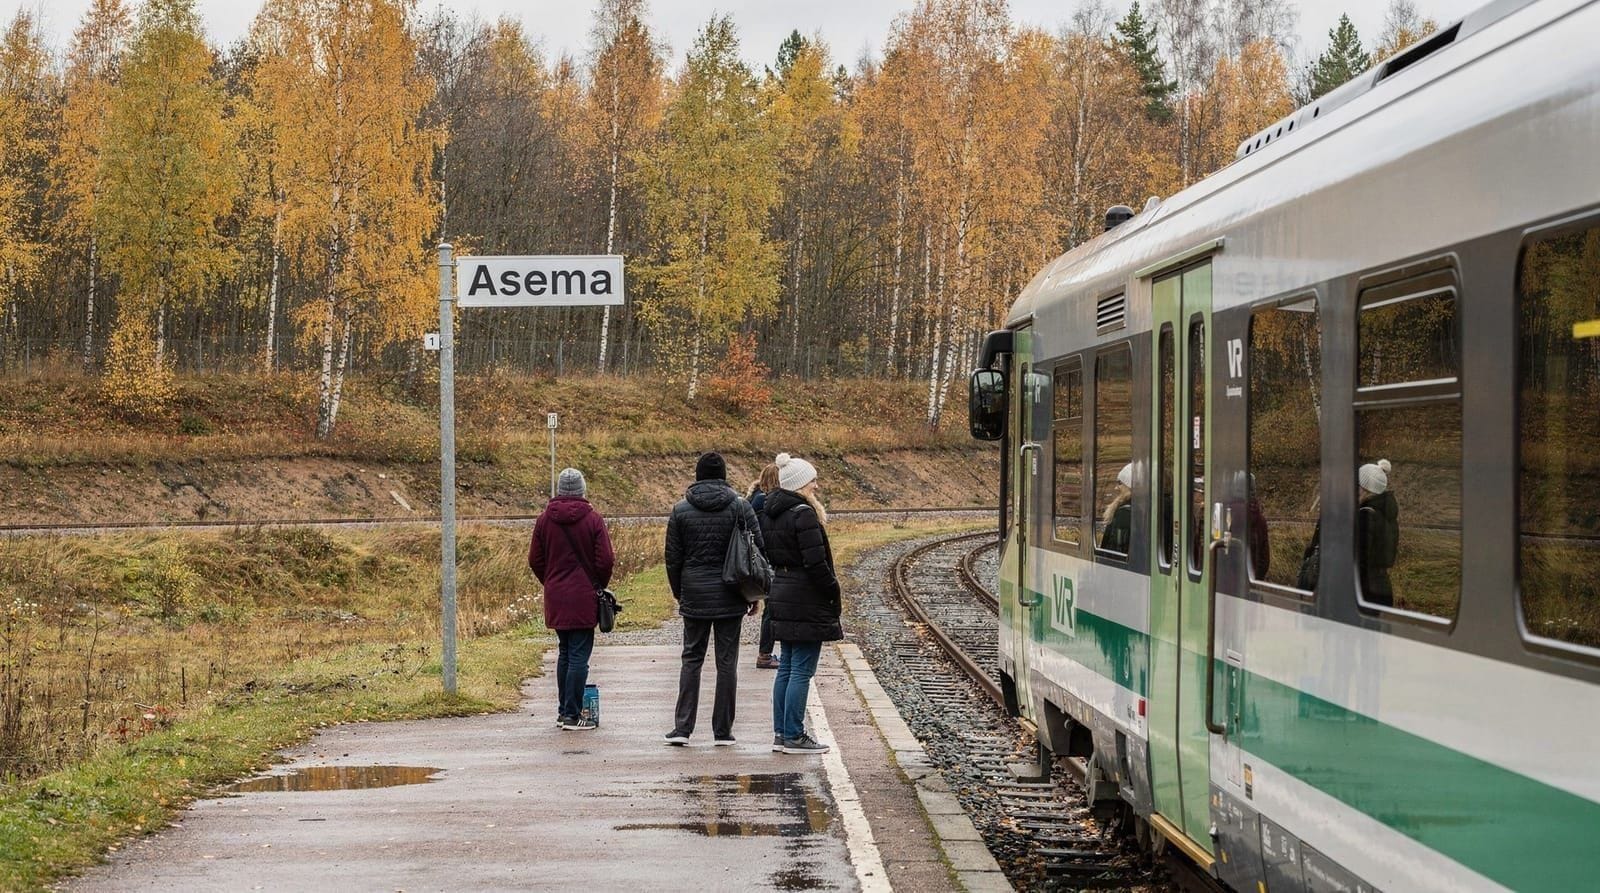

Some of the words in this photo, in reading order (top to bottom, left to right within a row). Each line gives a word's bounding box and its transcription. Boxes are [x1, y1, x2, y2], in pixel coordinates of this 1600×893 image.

[468, 264, 613, 296] Asema
[1227, 338, 1243, 378] VR
[1053, 573, 1074, 629] VR
